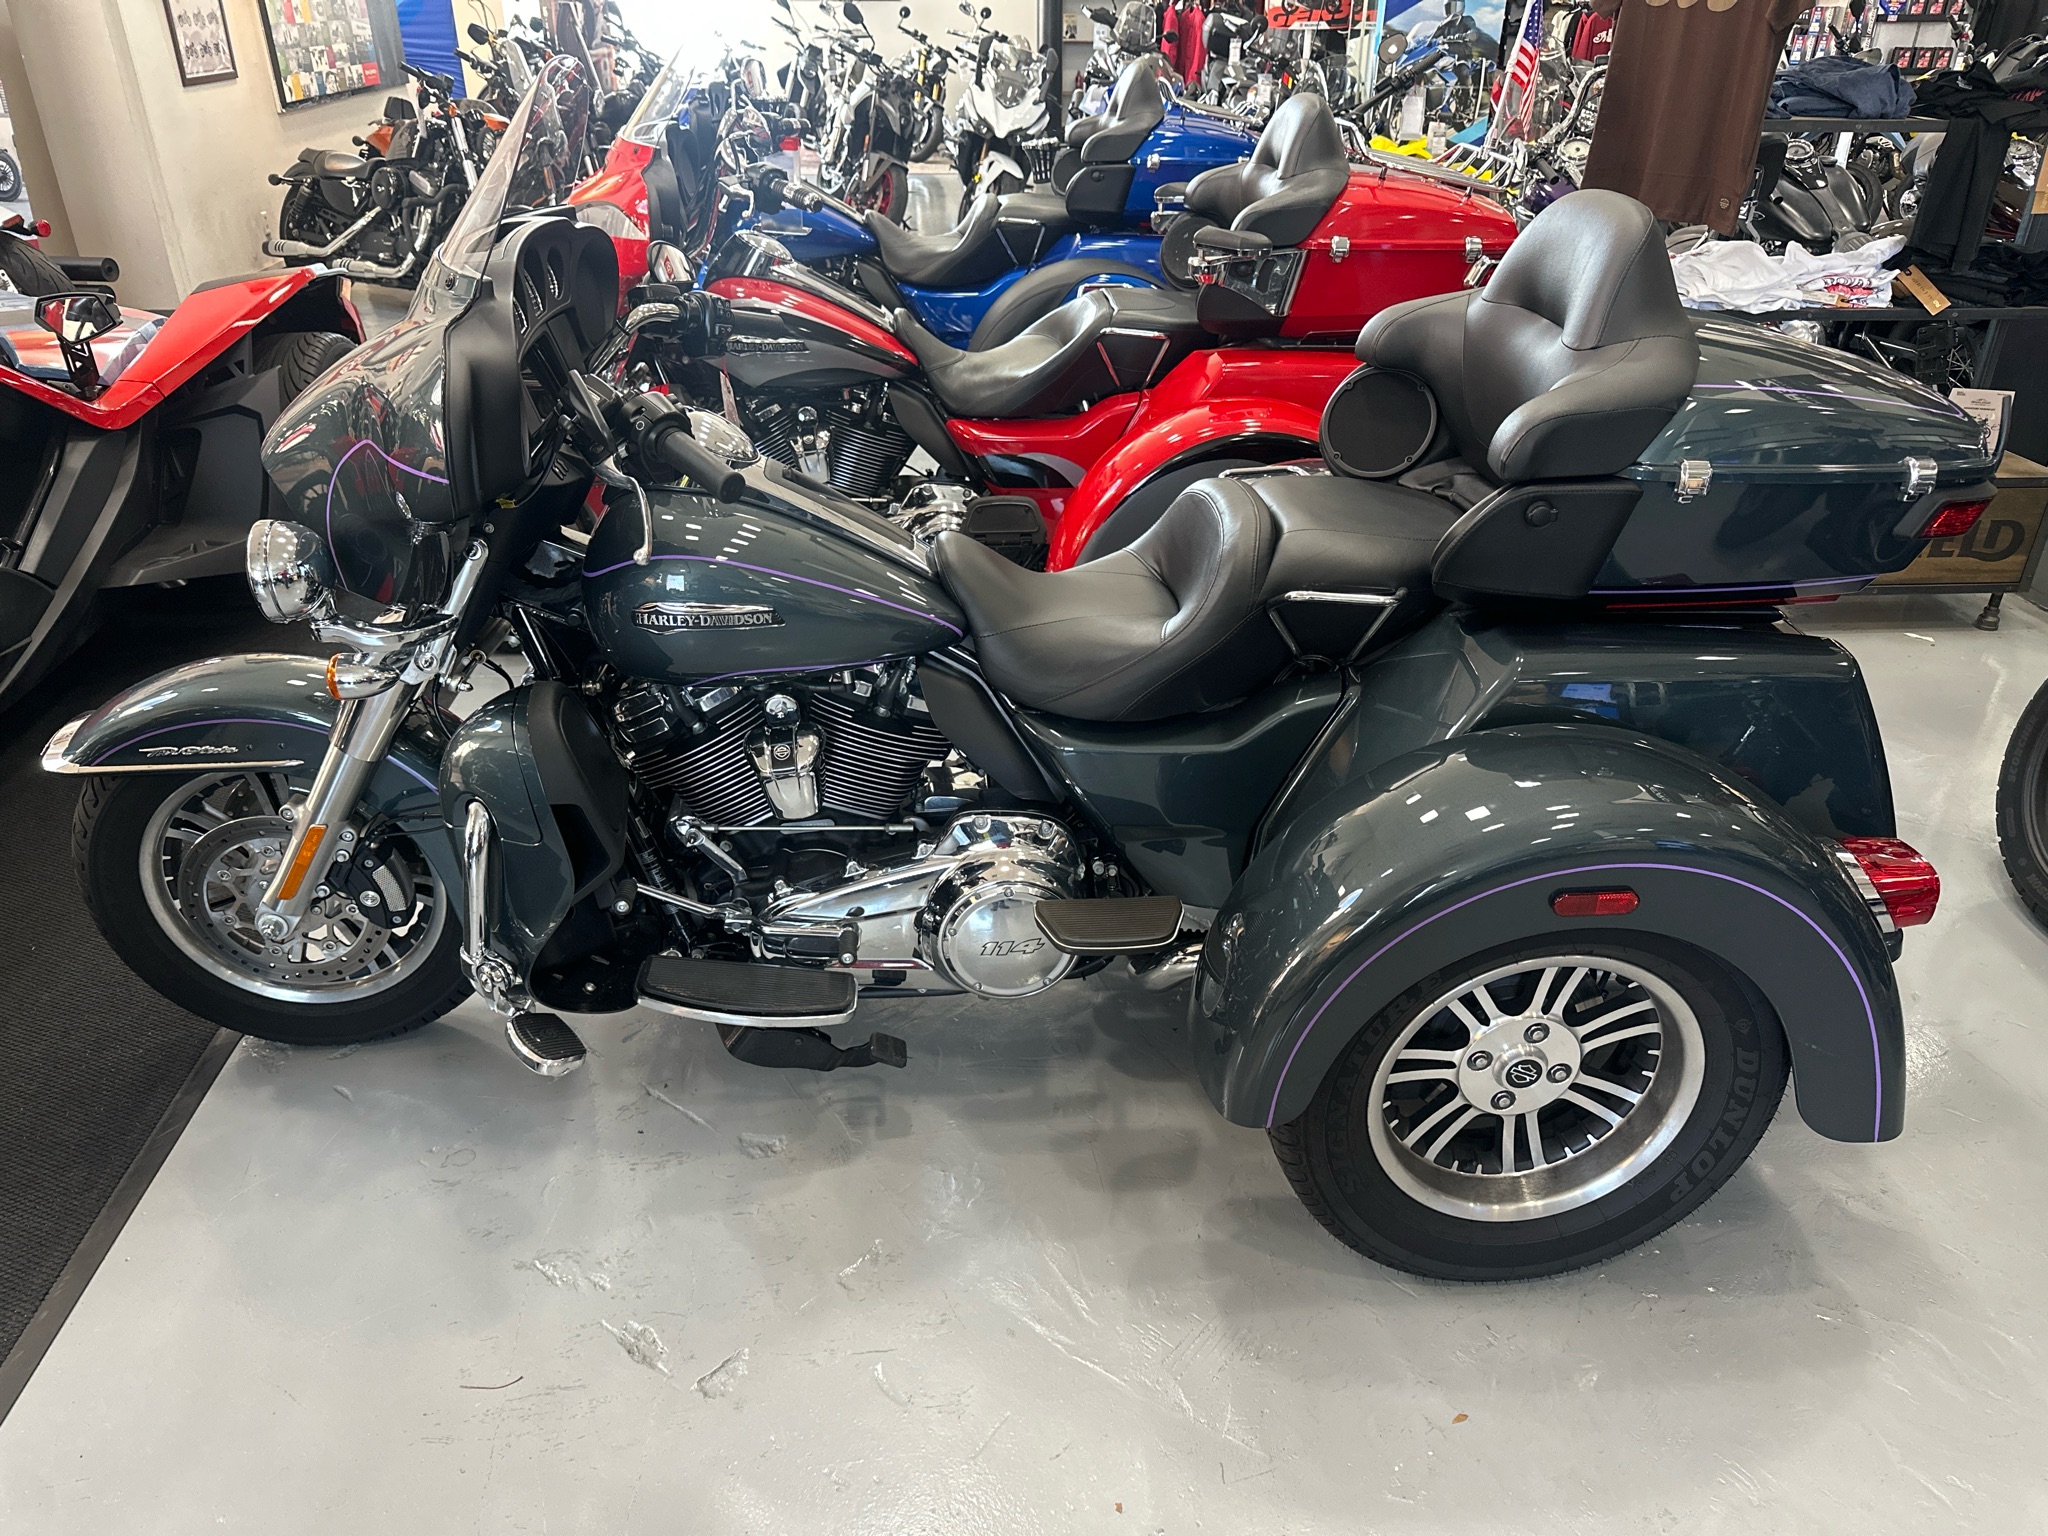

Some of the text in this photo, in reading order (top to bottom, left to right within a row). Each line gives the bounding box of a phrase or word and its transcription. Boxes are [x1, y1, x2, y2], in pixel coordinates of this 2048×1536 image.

[637, 612, 773, 627] HARLEY-DAVIDSON
[980, 938, 1045, 956] 114
[1670, 1047, 1760, 1203] DUNLOP
